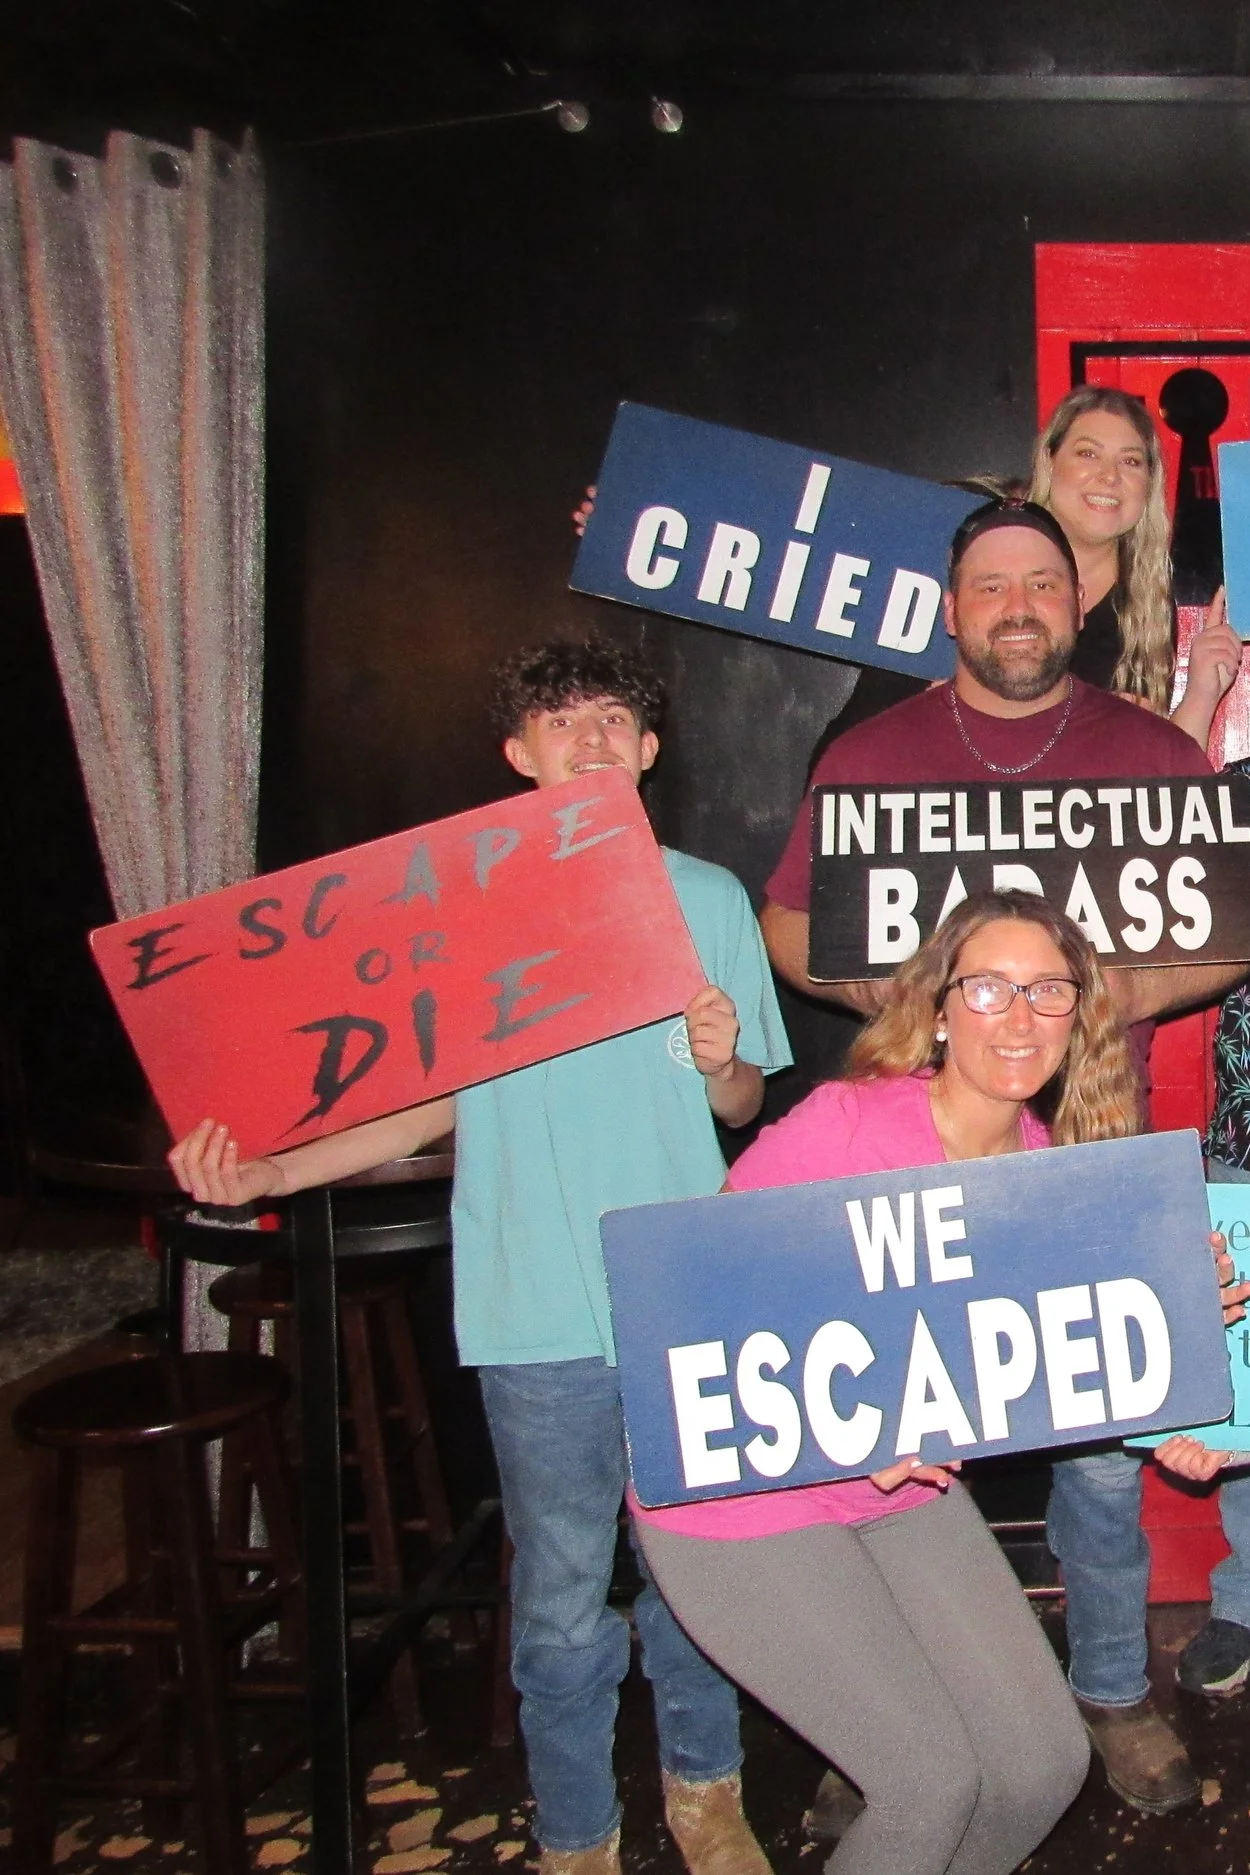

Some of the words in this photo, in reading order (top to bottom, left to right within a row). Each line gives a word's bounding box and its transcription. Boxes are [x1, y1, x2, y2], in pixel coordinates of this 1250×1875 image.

[794, 463, 832, 534] I
[625, 506, 943, 654] CRIED
[124, 796, 637, 994] ESCAPE
[355, 931, 450, 985] OR
[277, 949, 595, 1142] DIE
[845, 1185, 974, 1294] WE
[668, 1277, 1172, 1489] ESCAPED
